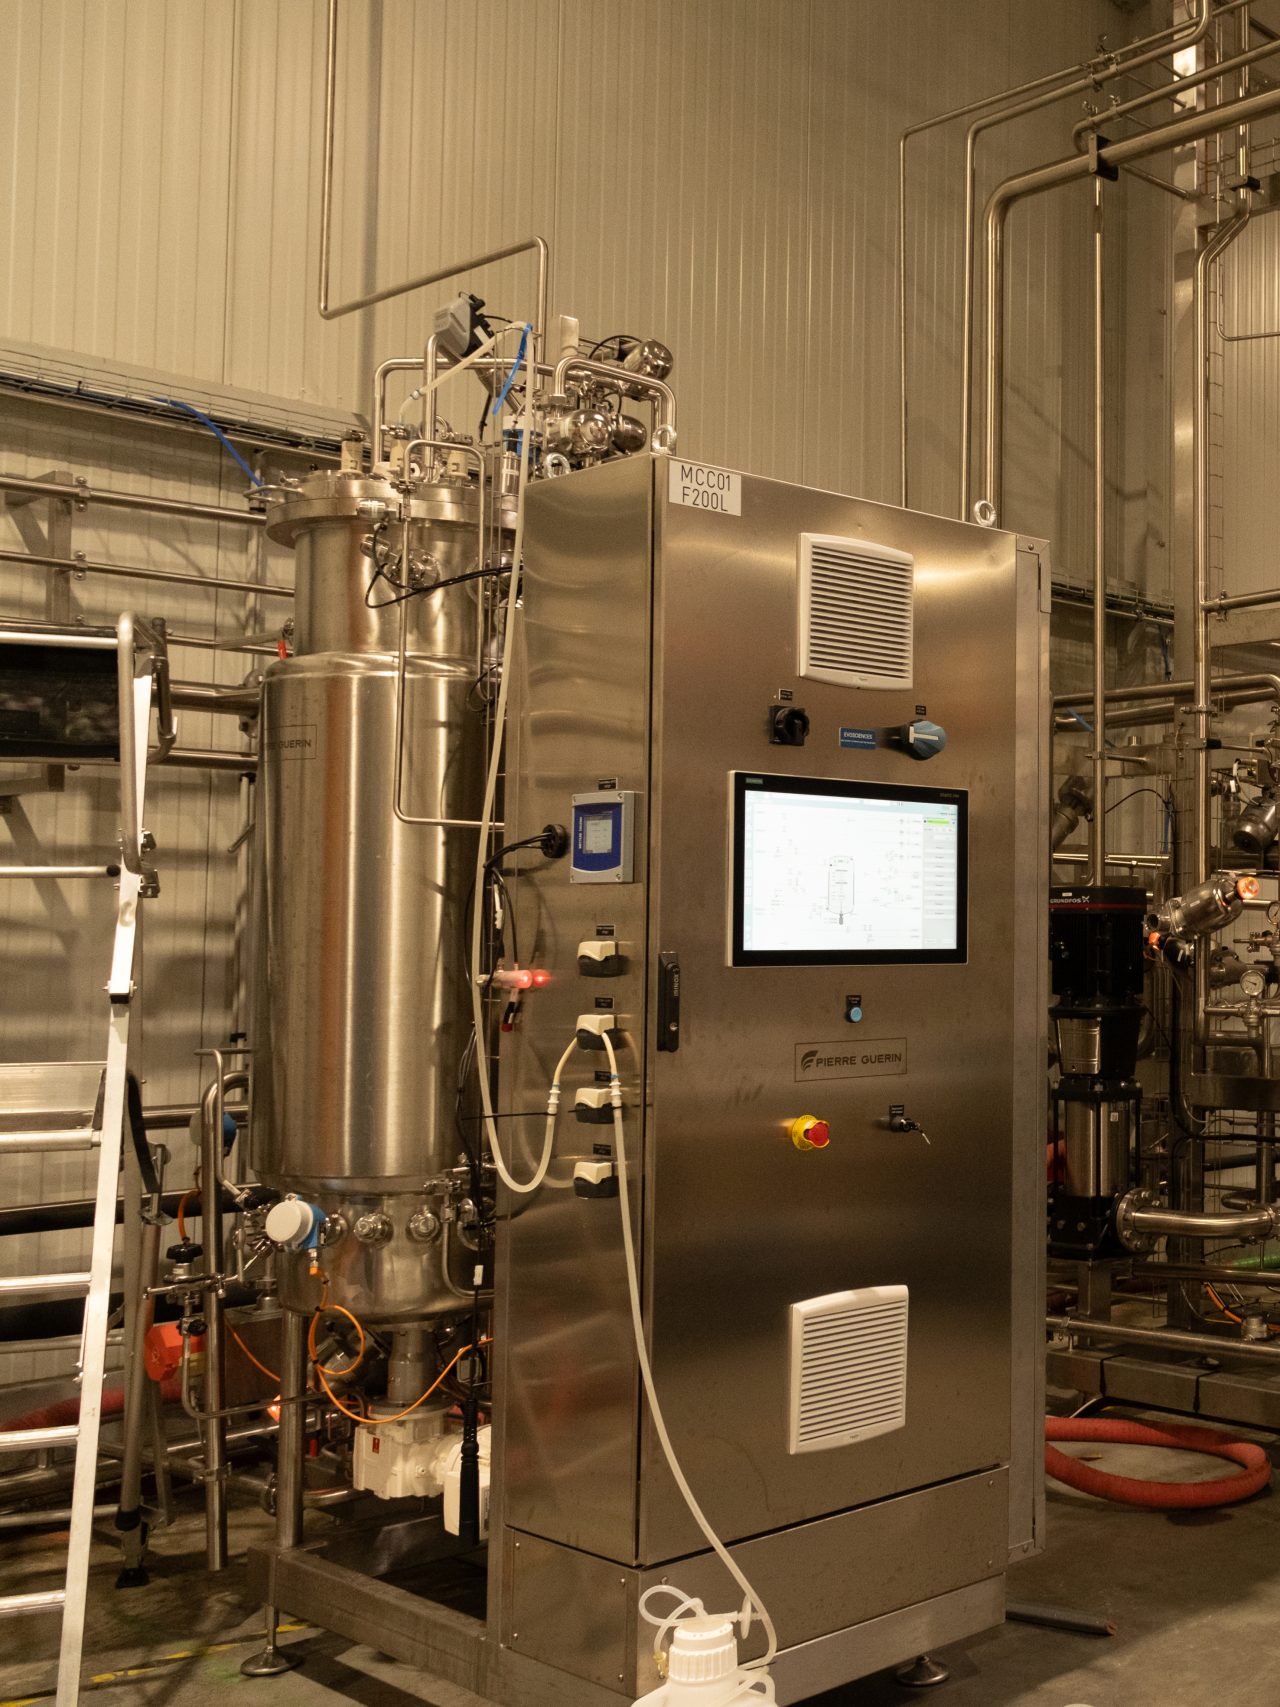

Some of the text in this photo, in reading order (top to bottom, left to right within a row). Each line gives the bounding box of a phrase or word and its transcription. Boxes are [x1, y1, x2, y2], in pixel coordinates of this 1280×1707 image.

[681, 464, 731, 492] MCC01
[682, 485, 729, 512] F200L
[816, 1053, 902, 1068] PIERRE GUERIN
